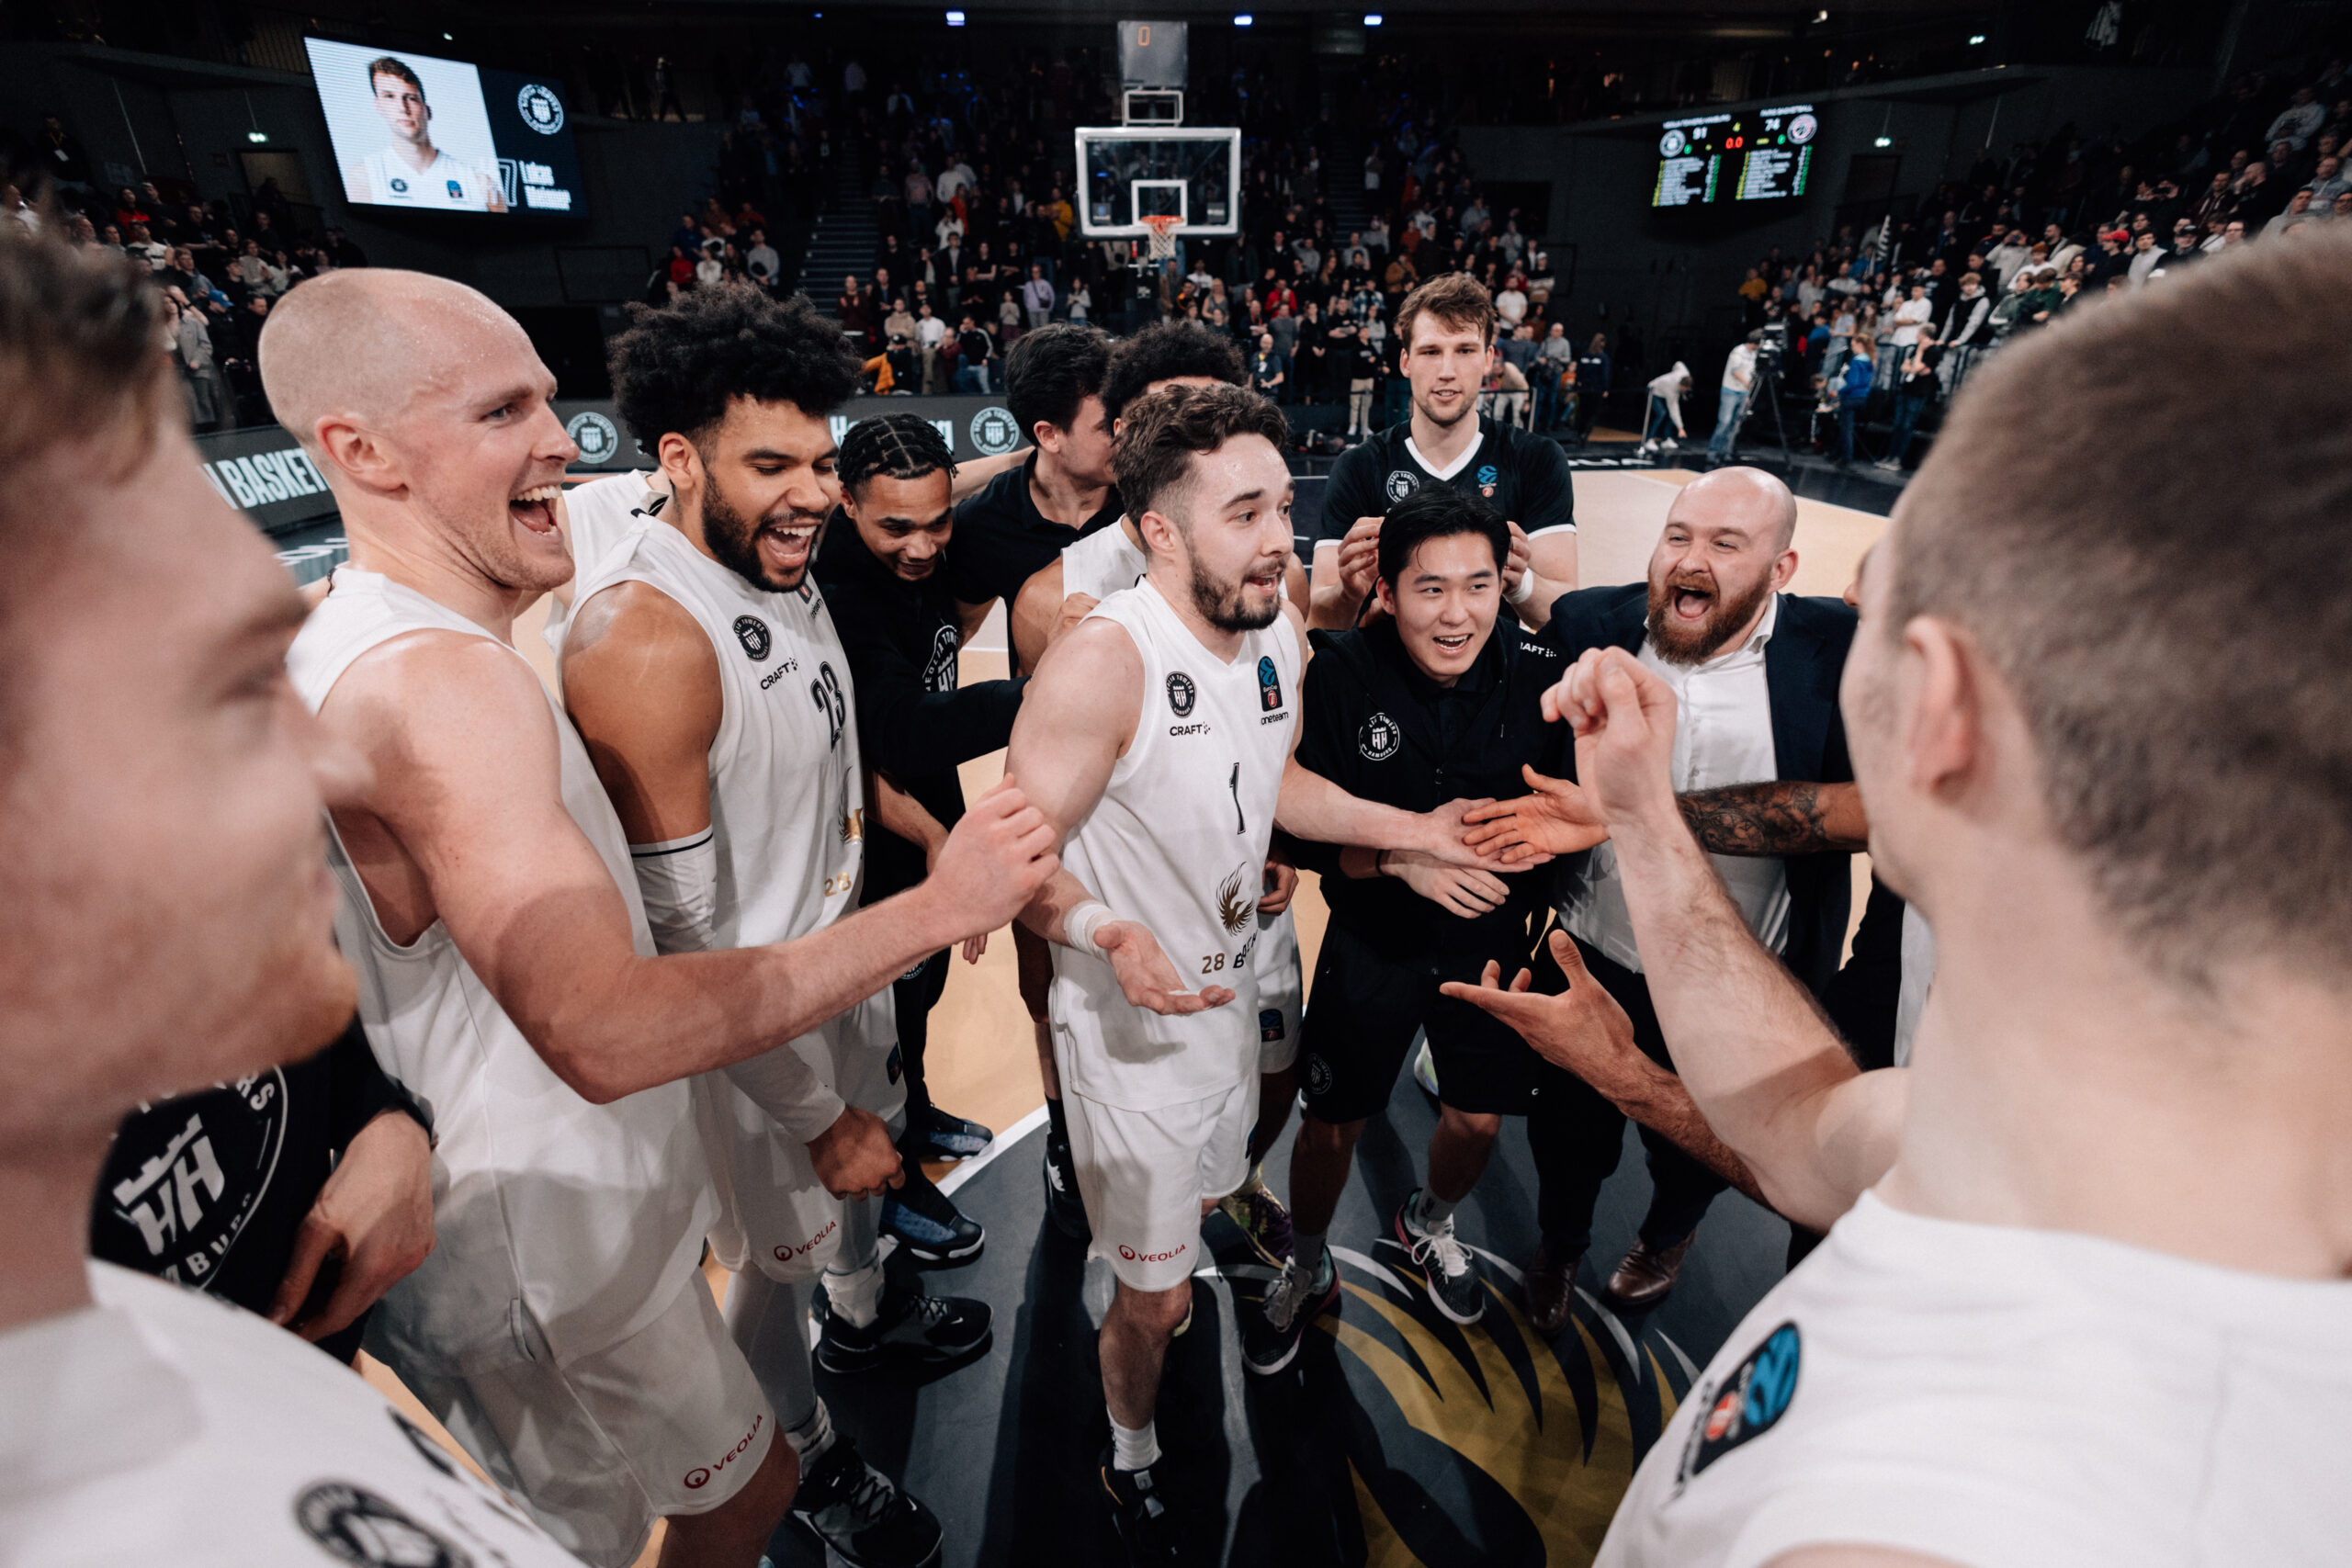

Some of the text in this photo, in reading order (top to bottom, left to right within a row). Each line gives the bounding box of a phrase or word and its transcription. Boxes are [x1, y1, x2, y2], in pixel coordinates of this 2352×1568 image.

[1137, 26, 1150, 46] 0
[760, 662, 790, 690] CRAFT
[810, 660, 846, 753] 23
[1169, 724, 1203, 737] CRAFT
[1229, 761, 1246, 835] 1
[824, 872, 852, 897] 28
[1202, 953, 1225, 975] 28
[796, 1221, 837, 1255] VEOLIA
[1138, 1244, 1186, 1262] VEOLIA
[713, 1415, 763, 1471] VEOLIA
